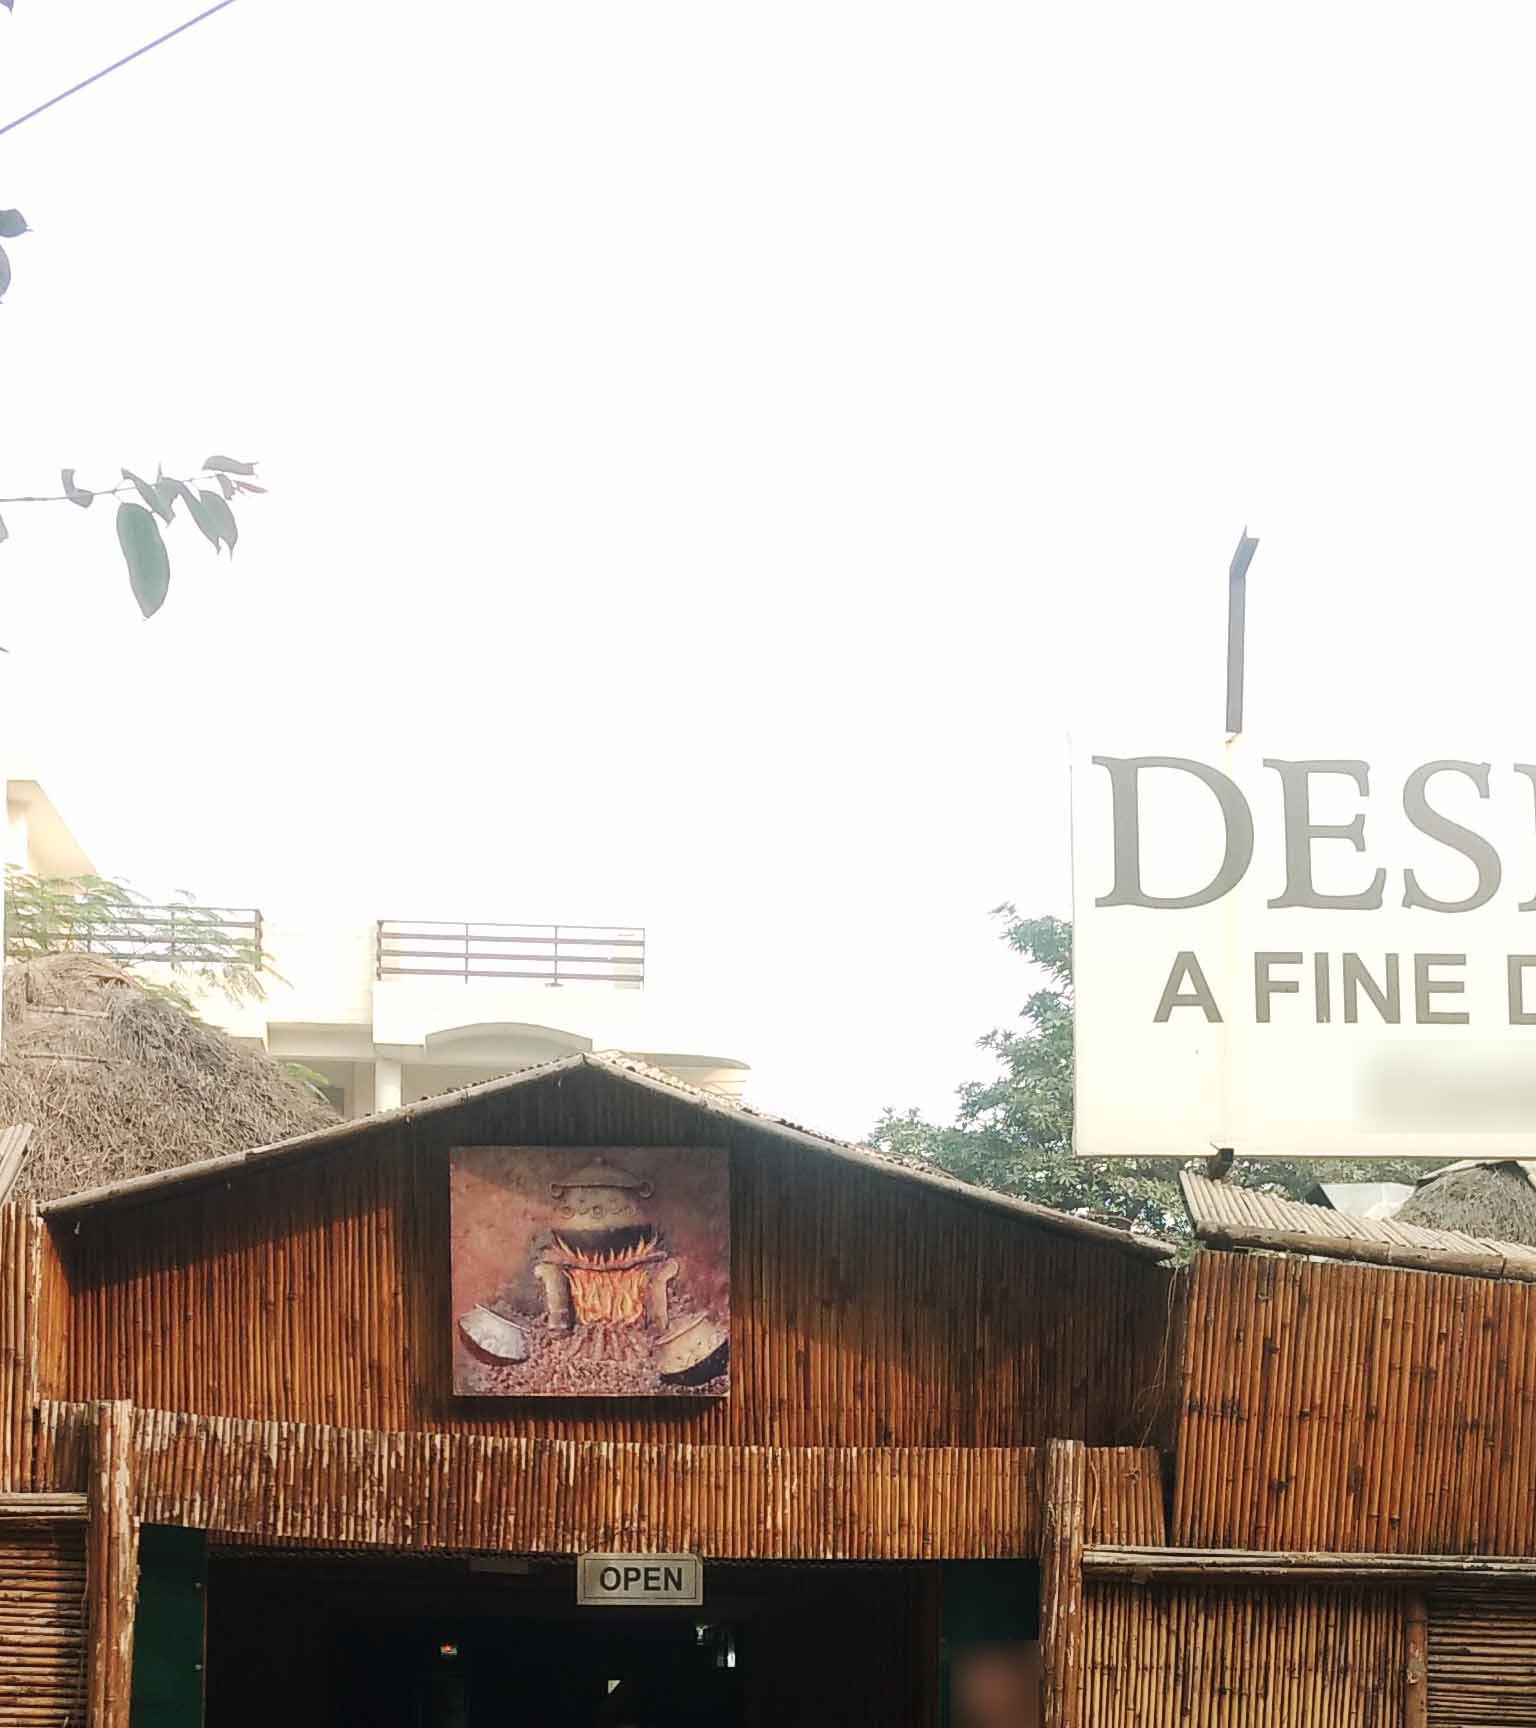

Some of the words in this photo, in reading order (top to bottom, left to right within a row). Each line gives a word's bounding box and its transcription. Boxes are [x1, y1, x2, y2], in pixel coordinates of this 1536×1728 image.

[1152, 951, 1224, 1024] A
[1254, 951, 1470, 1025] FINE
[600, 1566, 682, 1591] OPEN
